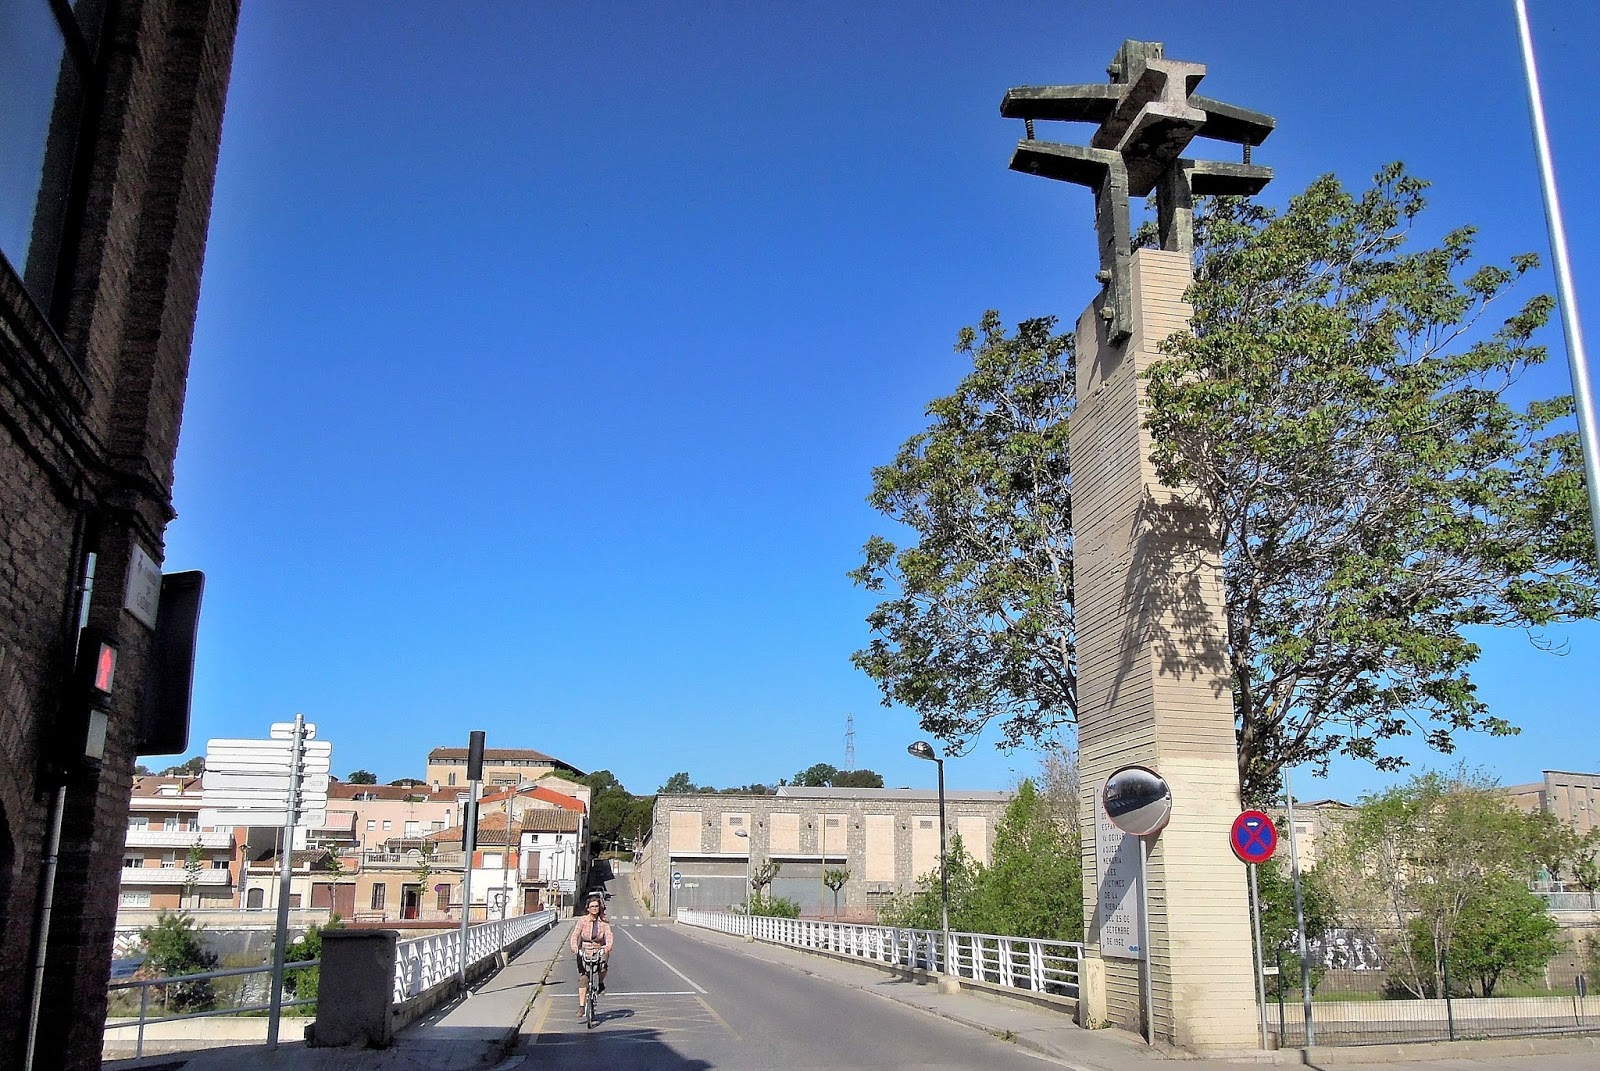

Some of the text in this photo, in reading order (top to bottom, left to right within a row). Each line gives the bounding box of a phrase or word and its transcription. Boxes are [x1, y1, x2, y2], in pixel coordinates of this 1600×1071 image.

[1105, 914, 1115, 923] DEL
[1123, 914, 1130, 923] DE
[1106, 925, 1130, 935] SETEMBRE
[1106, 937, 1124, 946] DE 1962
